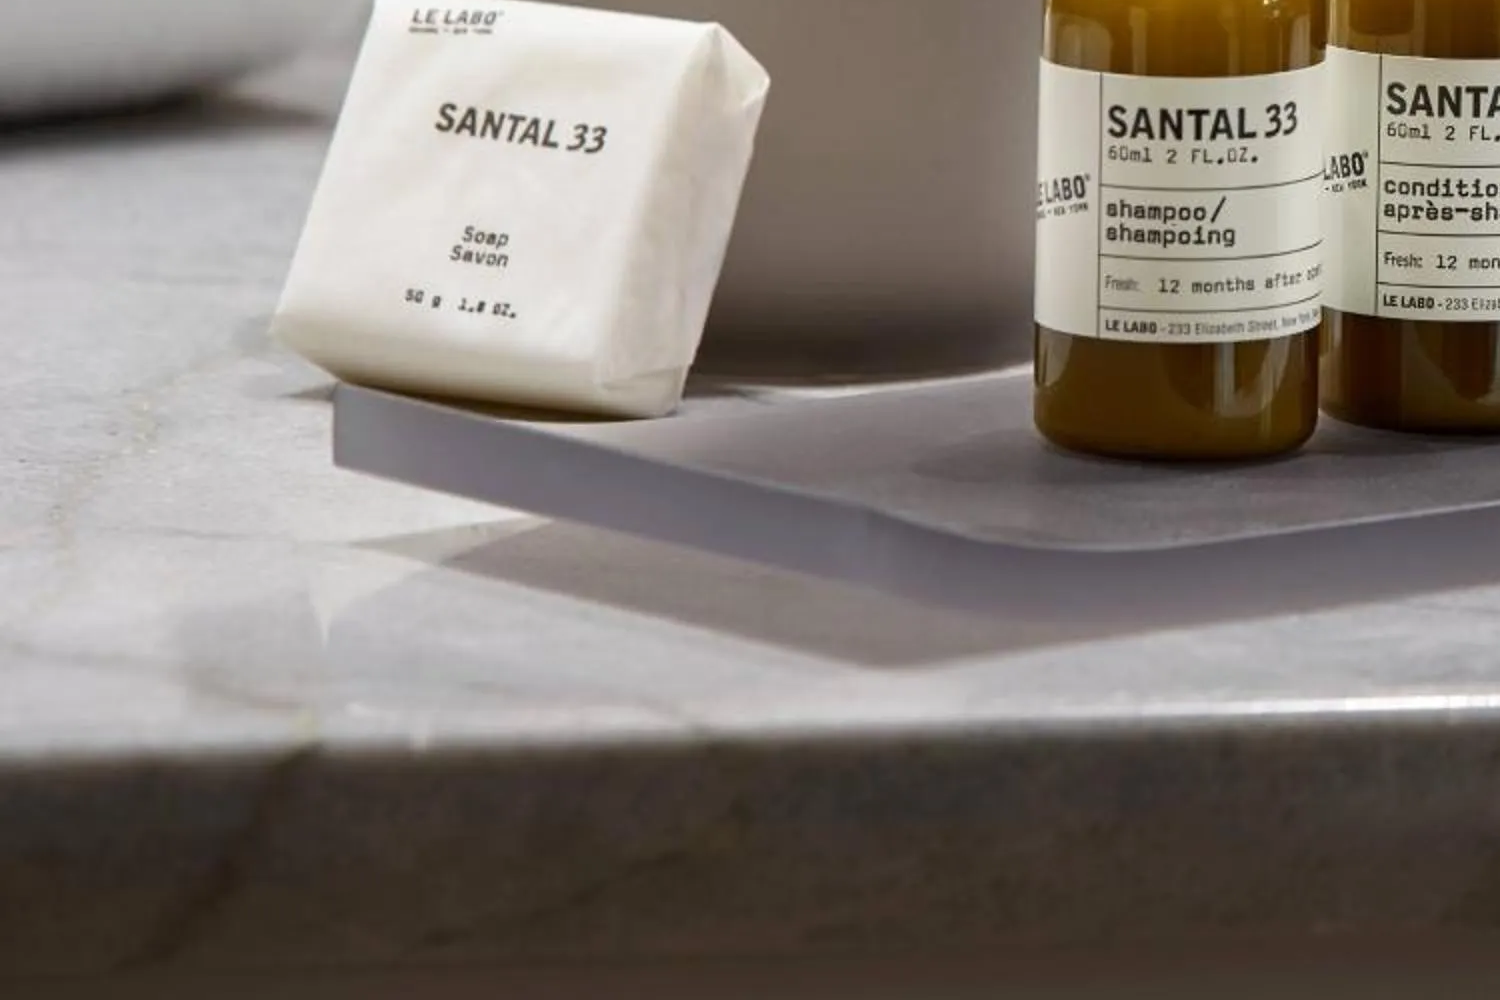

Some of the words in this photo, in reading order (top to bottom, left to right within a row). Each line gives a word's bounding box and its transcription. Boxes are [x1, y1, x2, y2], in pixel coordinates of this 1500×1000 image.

[412, 8, 438, 24] LE
[434, 101, 560, 149] SANTAL
[565, 122, 608, 154] 33
[1107, 104, 1257, 141] SANTAL
[1264, 101, 1298, 139] 33
[1386, 123, 1431, 140] 60ml
[1445, 126, 1456, 141] 2
[1108, 145, 1152, 163] 60ml
[1166, 150, 1177, 164] 2
[1106, 196, 1227, 227] shampoo/
[461, 225, 509, 250] Soap
[1106, 223, 1236, 248] shampoing
[449, 244, 509, 268] Savon
[1436, 254, 1457, 270] 12
[1158, 279, 1180, 294] 12
[1191, 277, 1255, 294] months
[1264, 272, 1302, 290] after
[1383, 293, 1398, 307] LE
[1401, 295, 1435, 310] LABO
[1445, 298, 1469, 311] 233
[1105, 319, 1121, 332] LE
[1123, 320, 1157, 335] LABO
[1167, 323, 1191, 336] 233
